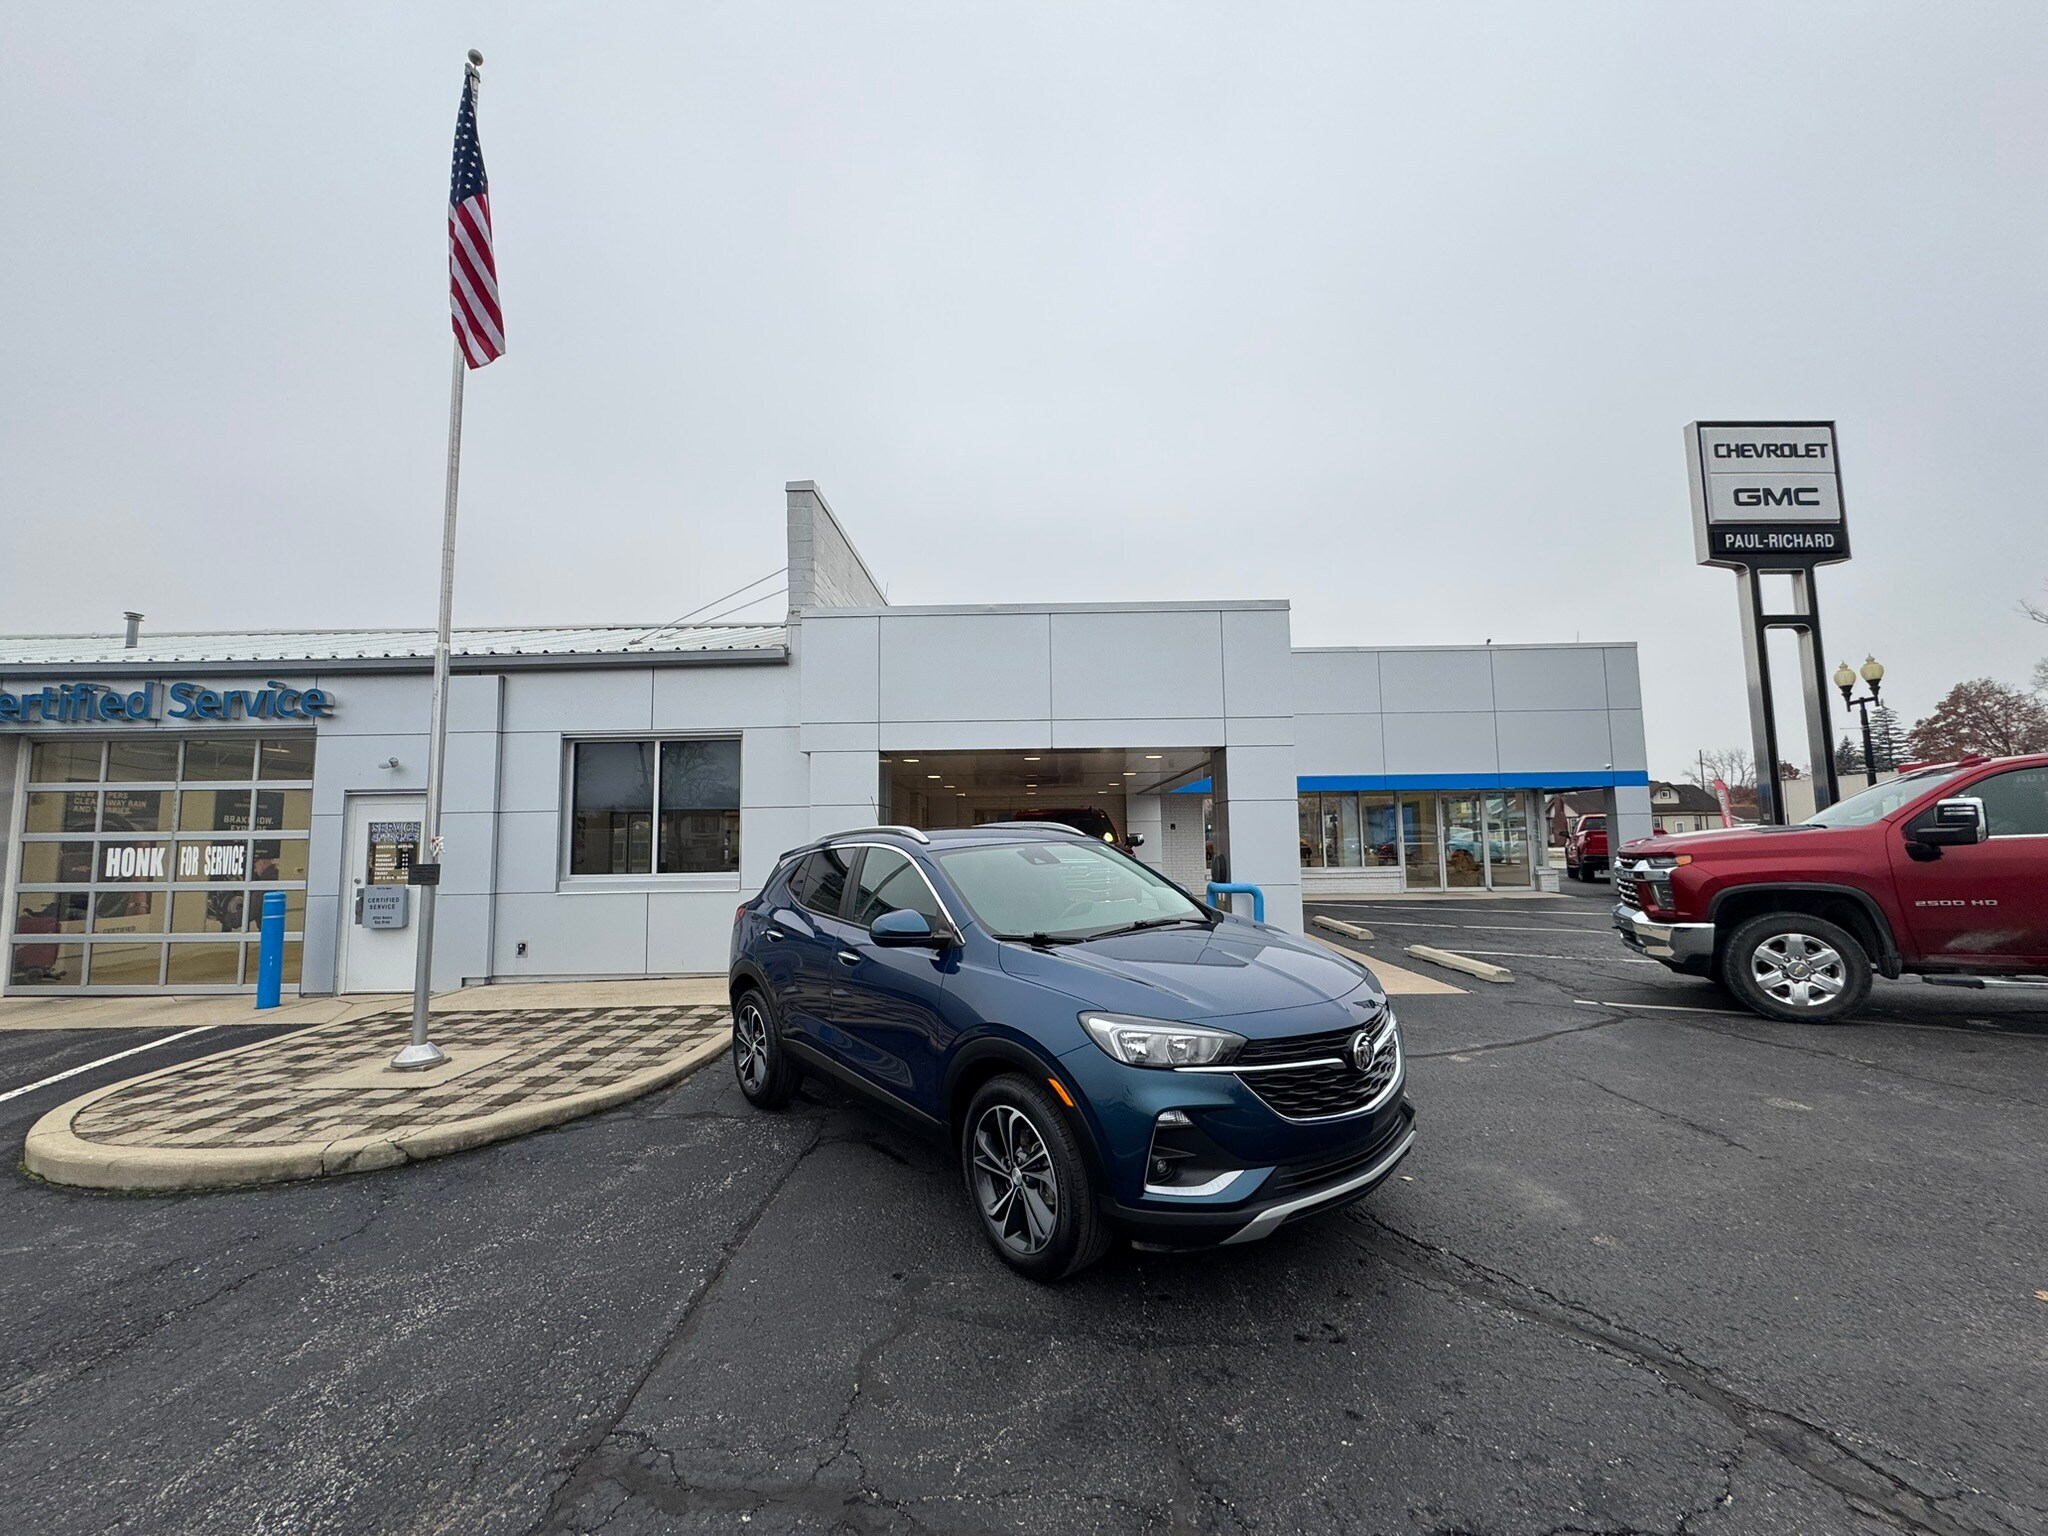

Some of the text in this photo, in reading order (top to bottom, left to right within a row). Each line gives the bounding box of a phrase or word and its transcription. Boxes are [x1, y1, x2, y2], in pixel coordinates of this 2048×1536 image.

[1714, 443, 1828, 459] CHEVROLET
[1733, 487, 1820, 506] GMC
[1725, 534, 1835, 549] PAUL-RICHARD
[0, 680, 327, 721] ertified Service
[73, 797, 96, 805] CLEA
[73, 805, 92, 813] AND
[371, 823, 420, 833] SERVICE
[105, 845, 244, 877] HONK FOR SERVICE
[367, 896, 400, 904] CERTIFIED
